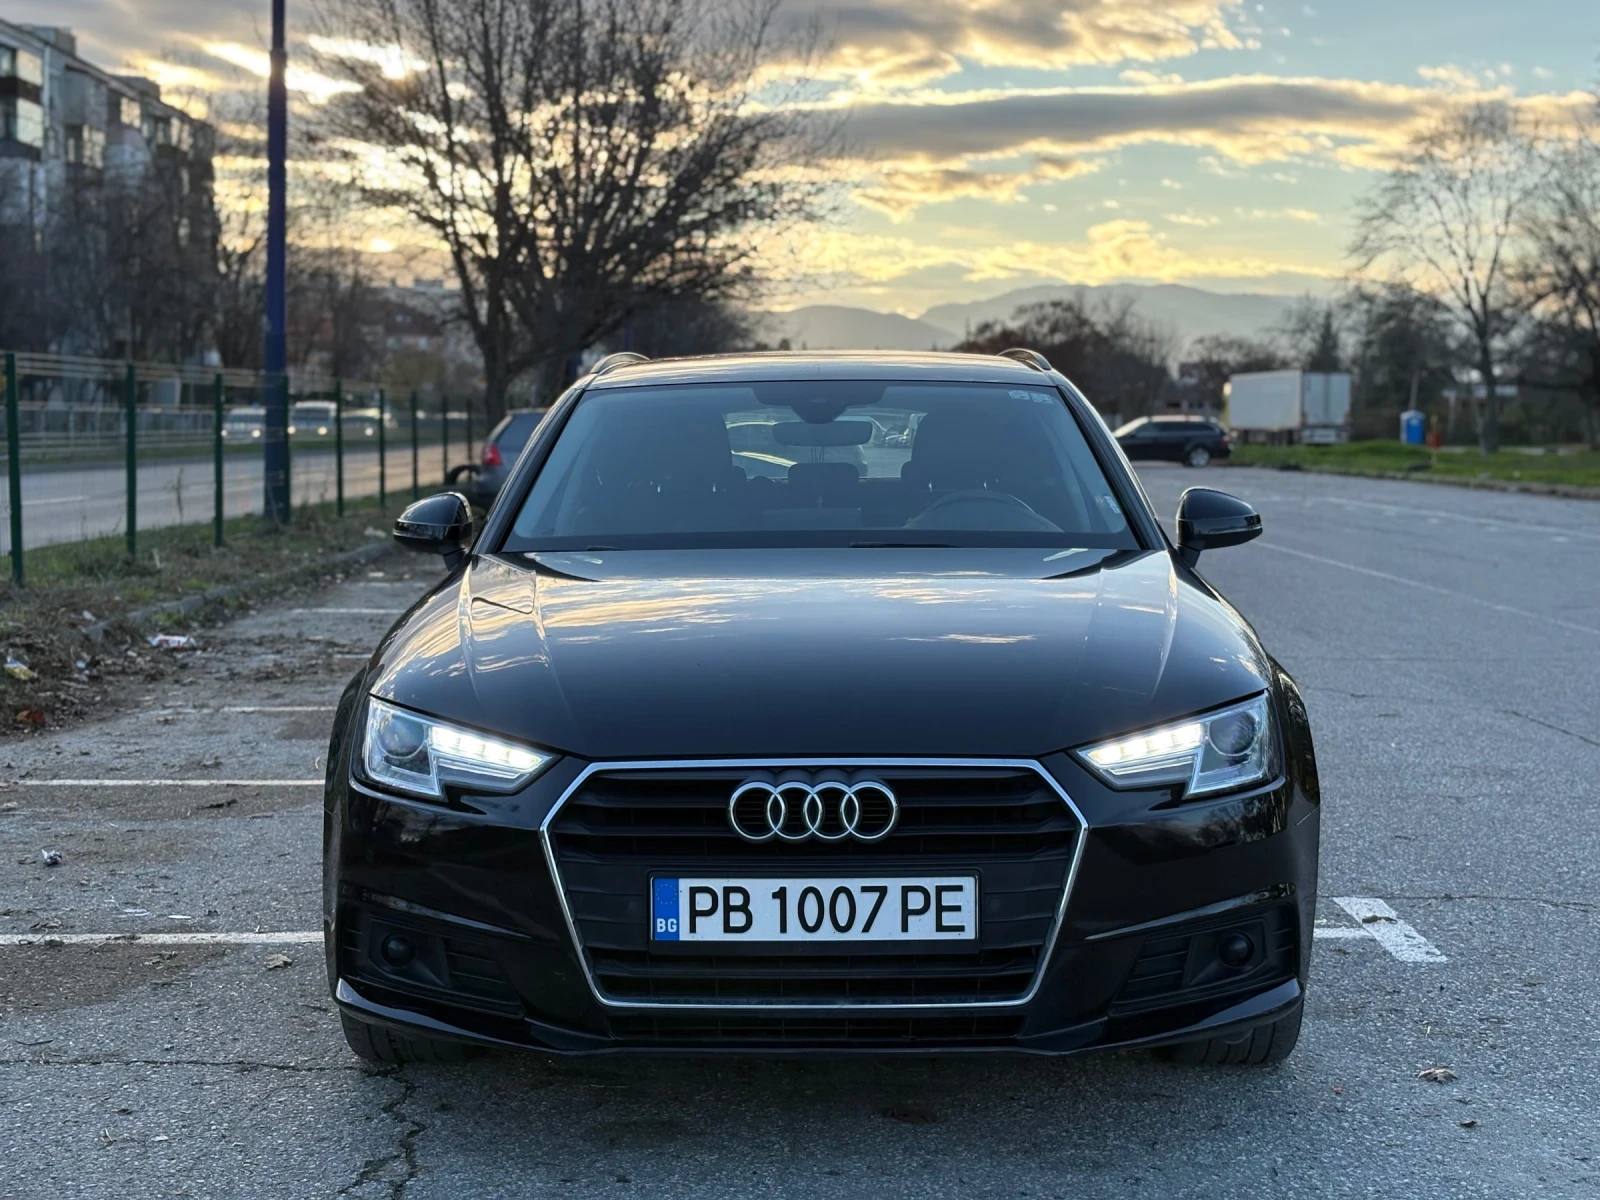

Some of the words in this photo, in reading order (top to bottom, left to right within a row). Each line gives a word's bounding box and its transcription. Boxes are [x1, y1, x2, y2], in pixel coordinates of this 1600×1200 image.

[656, 918, 677, 933] BG
[688, 885, 753, 934] PB
[771, 885, 888, 934] 1007
[901, 885, 966, 933] PE
